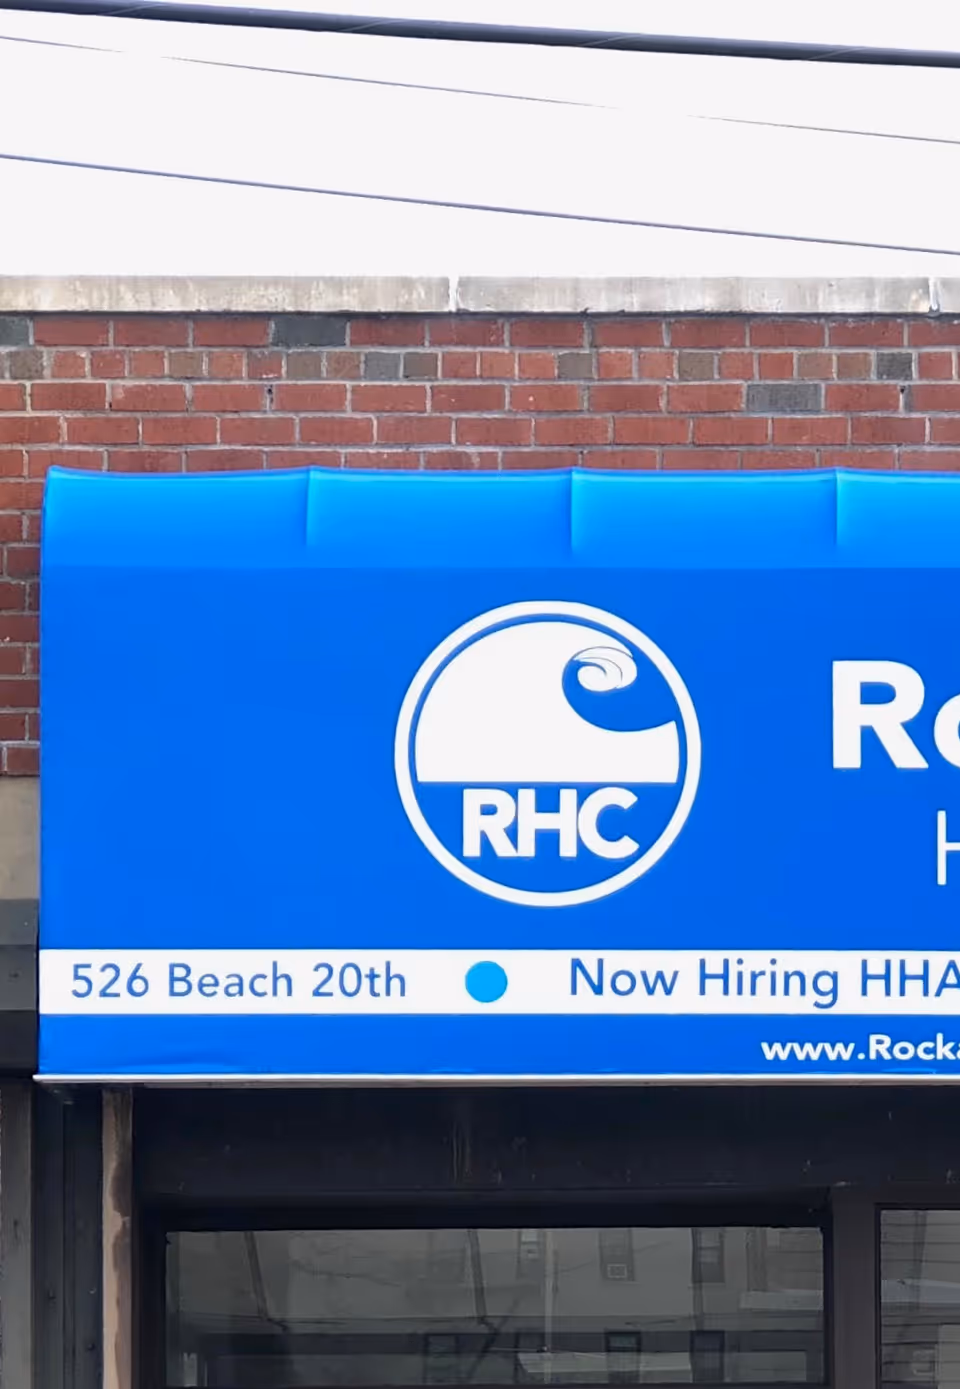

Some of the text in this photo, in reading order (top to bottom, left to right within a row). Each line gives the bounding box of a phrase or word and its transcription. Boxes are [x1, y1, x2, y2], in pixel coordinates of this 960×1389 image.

[463, 786, 640, 860] RHC
[72, 960, 407, 998] 526 Beach 20th
[570, 958, 679, 997] Now
[699, 958, 839, 1010] Hiring
